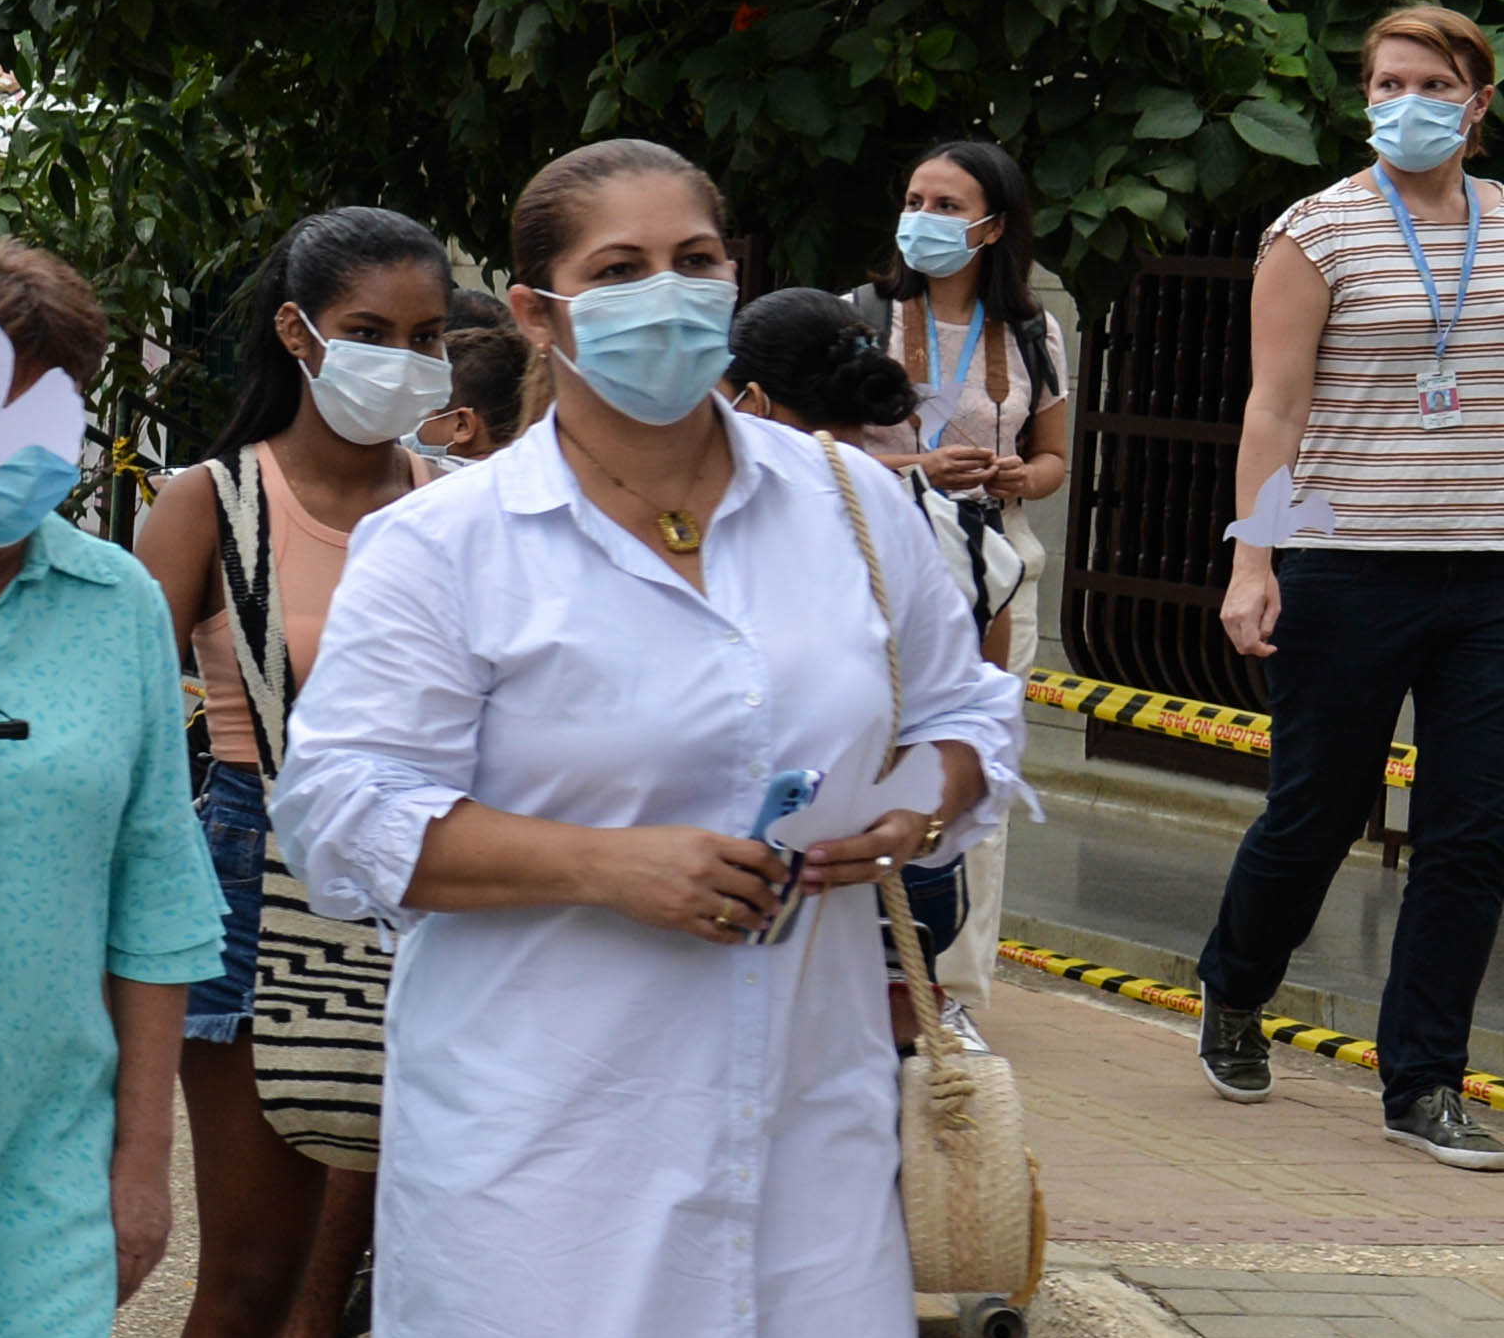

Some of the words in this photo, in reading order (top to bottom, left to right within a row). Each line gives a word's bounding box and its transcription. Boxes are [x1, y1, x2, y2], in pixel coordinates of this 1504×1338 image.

[1157, 711, 1190, 732] PASE
[1192, 718, 1214, 735] NO
[1141, 986, 1199, 1014] PELIGRO
